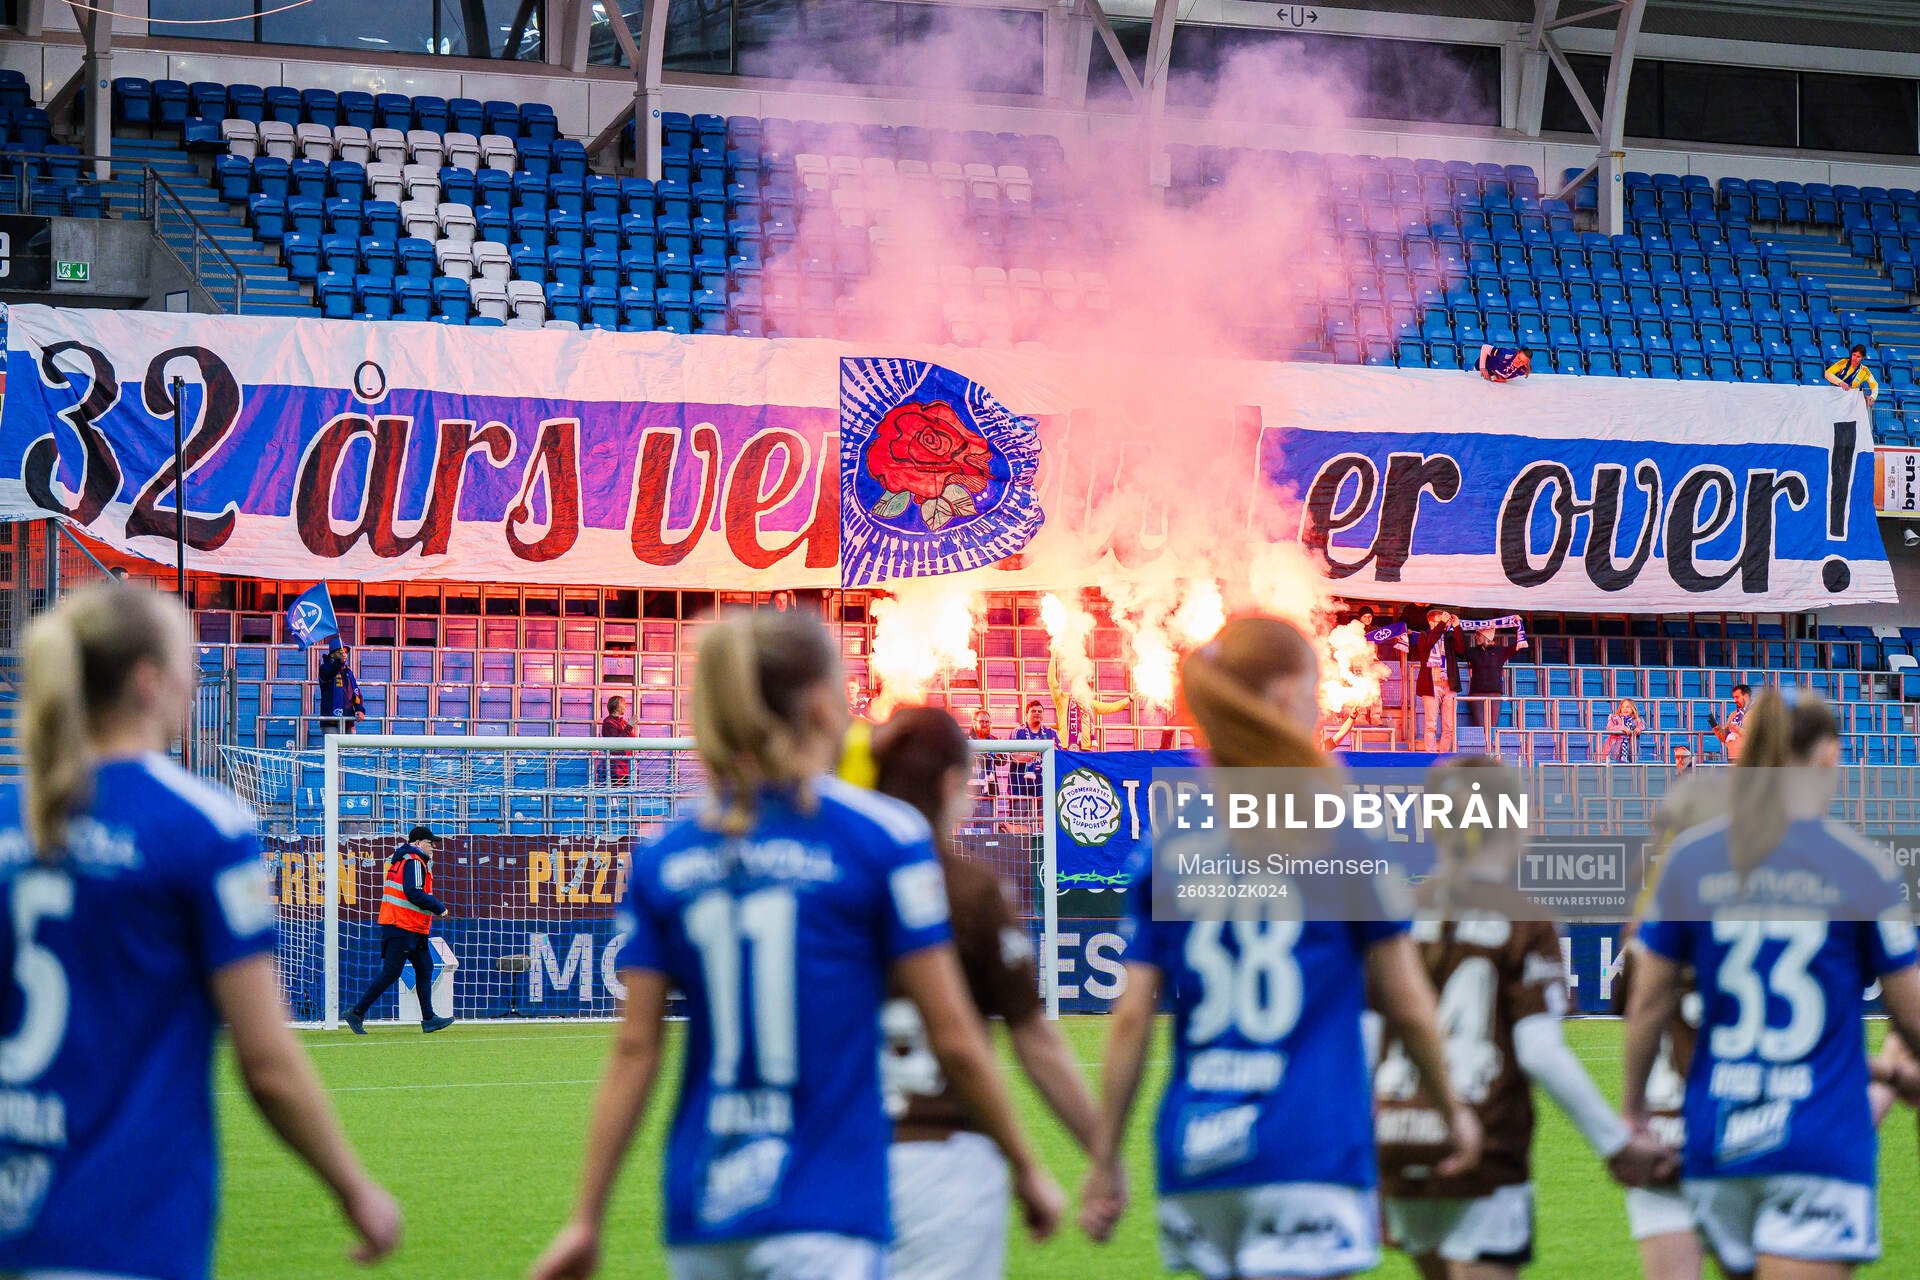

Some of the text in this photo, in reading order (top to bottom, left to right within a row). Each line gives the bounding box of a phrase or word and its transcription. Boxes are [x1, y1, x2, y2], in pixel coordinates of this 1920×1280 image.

[25, 340, 240, 551] 32
[296, 360, 579, 562] års
[1303, 452, 1460, 583] er
[1500, 420, 1857, 593] over!
[1901, 455, 1915, 510] brus
[1460, 619, 1496, 629] OLDE
[1072, 818, 1108, 830] SUPPORTER
[1526, 854, 1616, 880] TINGH
[1521, 896, 1626, 906] ERKEVARESTUDIO
[0, 866, 74, 1084] 5
[683, 887, 799, 1087] 11
[1178, 872, 1304, 1044] 38
[1709, 904, 1828, 1063] 33
